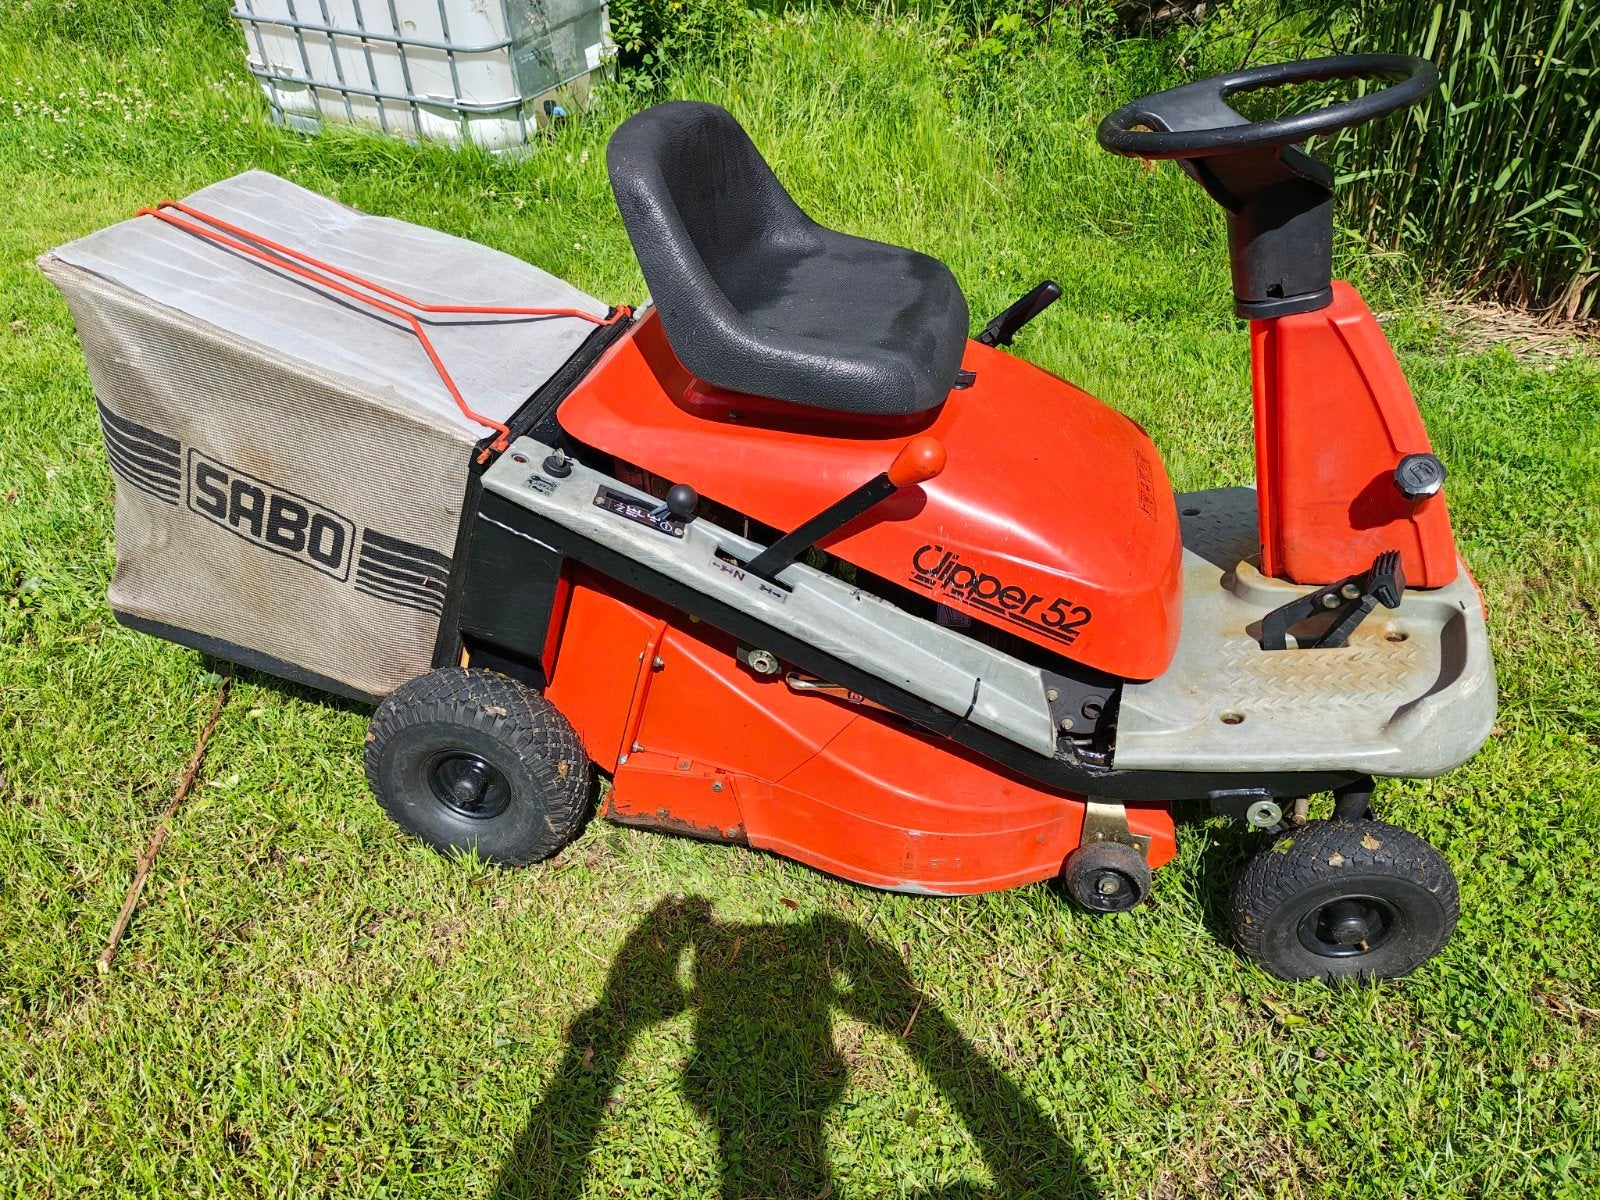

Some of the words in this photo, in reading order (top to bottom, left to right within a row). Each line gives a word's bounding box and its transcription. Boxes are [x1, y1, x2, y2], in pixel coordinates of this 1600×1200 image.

[195, 462, 345, 570] SABO
[912, 544, 1044, 615] Clipper
[1040, 597, 1092, 637] 52
